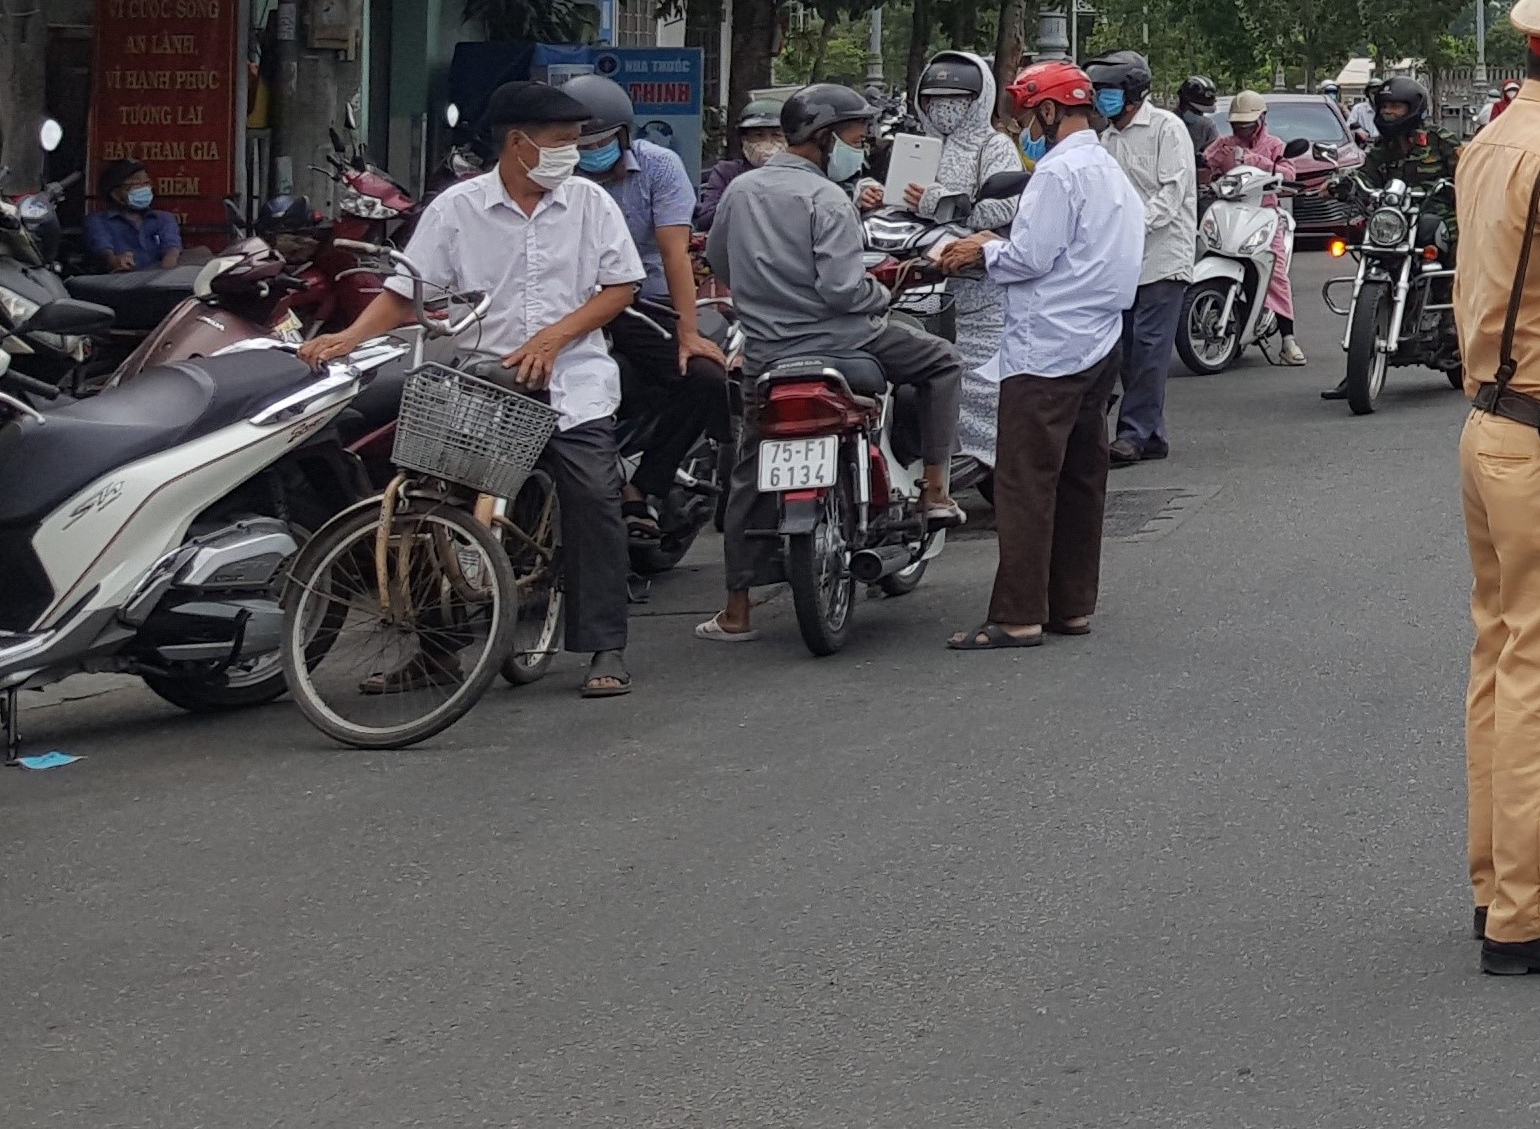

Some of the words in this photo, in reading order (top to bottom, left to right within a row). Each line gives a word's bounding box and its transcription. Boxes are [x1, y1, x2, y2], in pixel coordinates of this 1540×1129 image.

[175, 65, 220, 89] PHÚC
[177, 106, 203, 125] LAI
[140, 141, 185, 160] THAM
[190, 141, 220, 160] GIA
[771, 440, 826, 464] 75-F1
[770, 464, 824, 487] 6134
